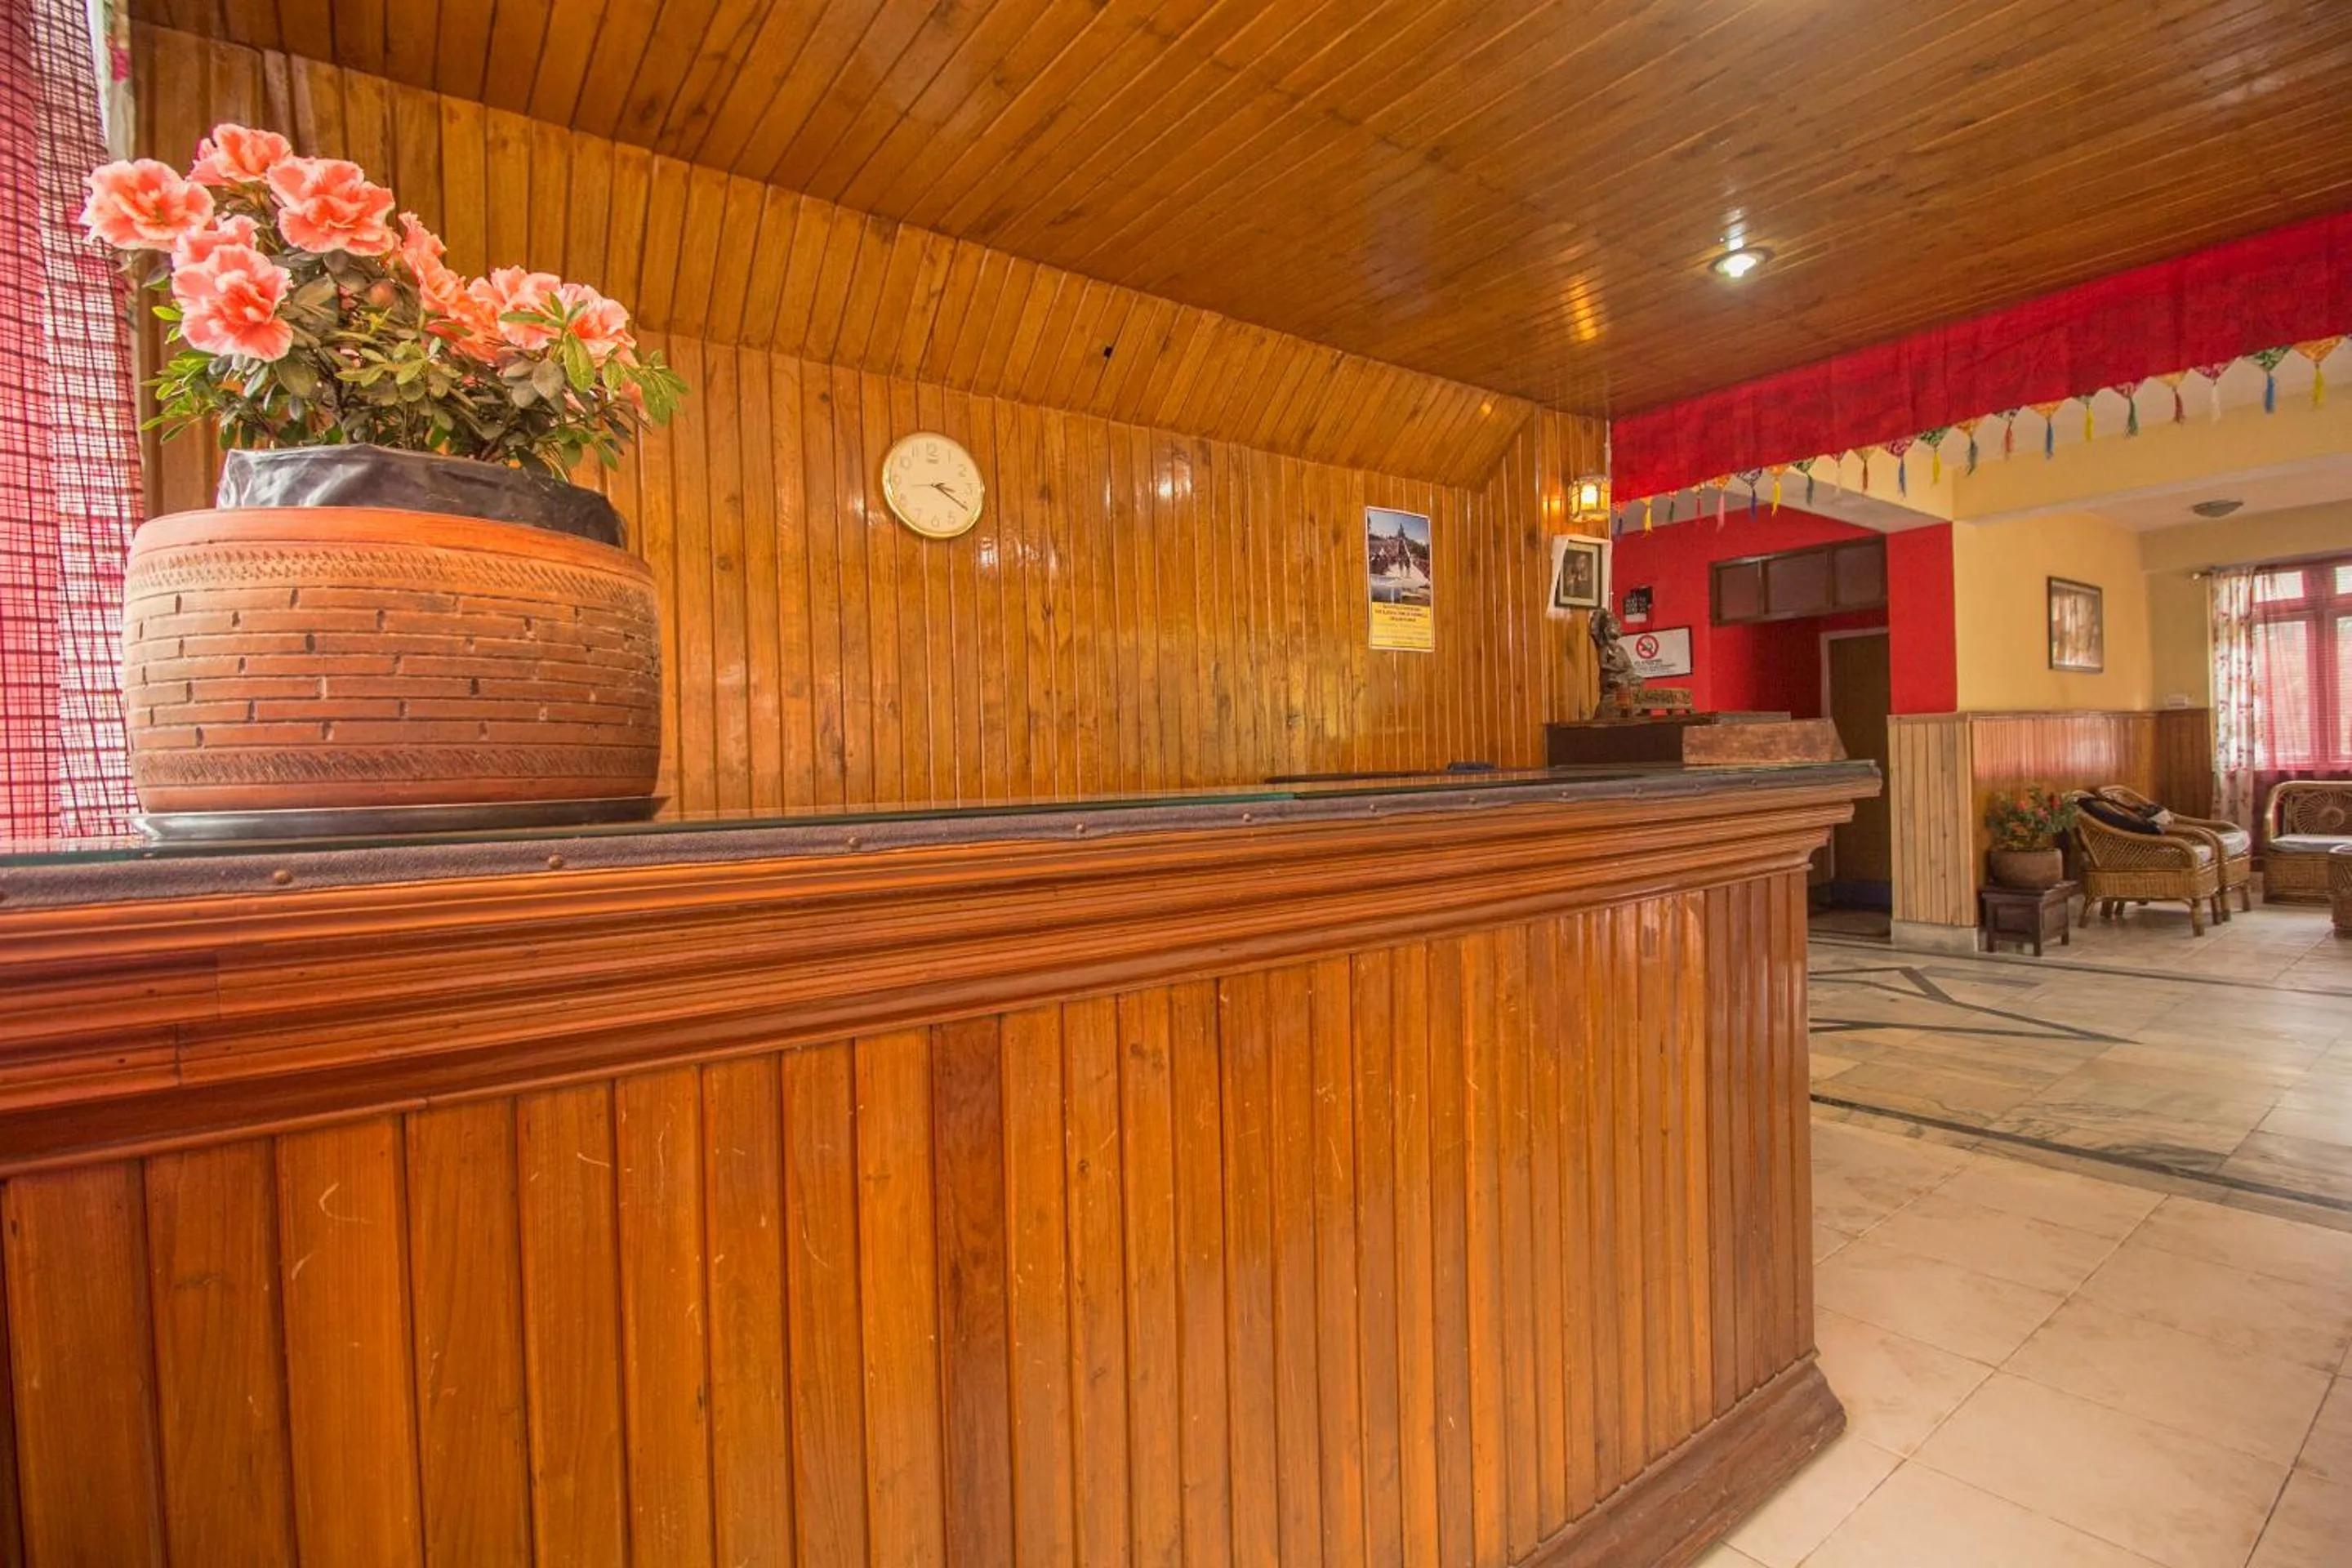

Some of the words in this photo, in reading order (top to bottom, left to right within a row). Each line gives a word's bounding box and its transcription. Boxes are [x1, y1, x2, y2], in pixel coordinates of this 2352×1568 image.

[926, 442, 938, 457] 12
[957, 464, 966, 477] 2
[931, 514, 940, 528] 6
